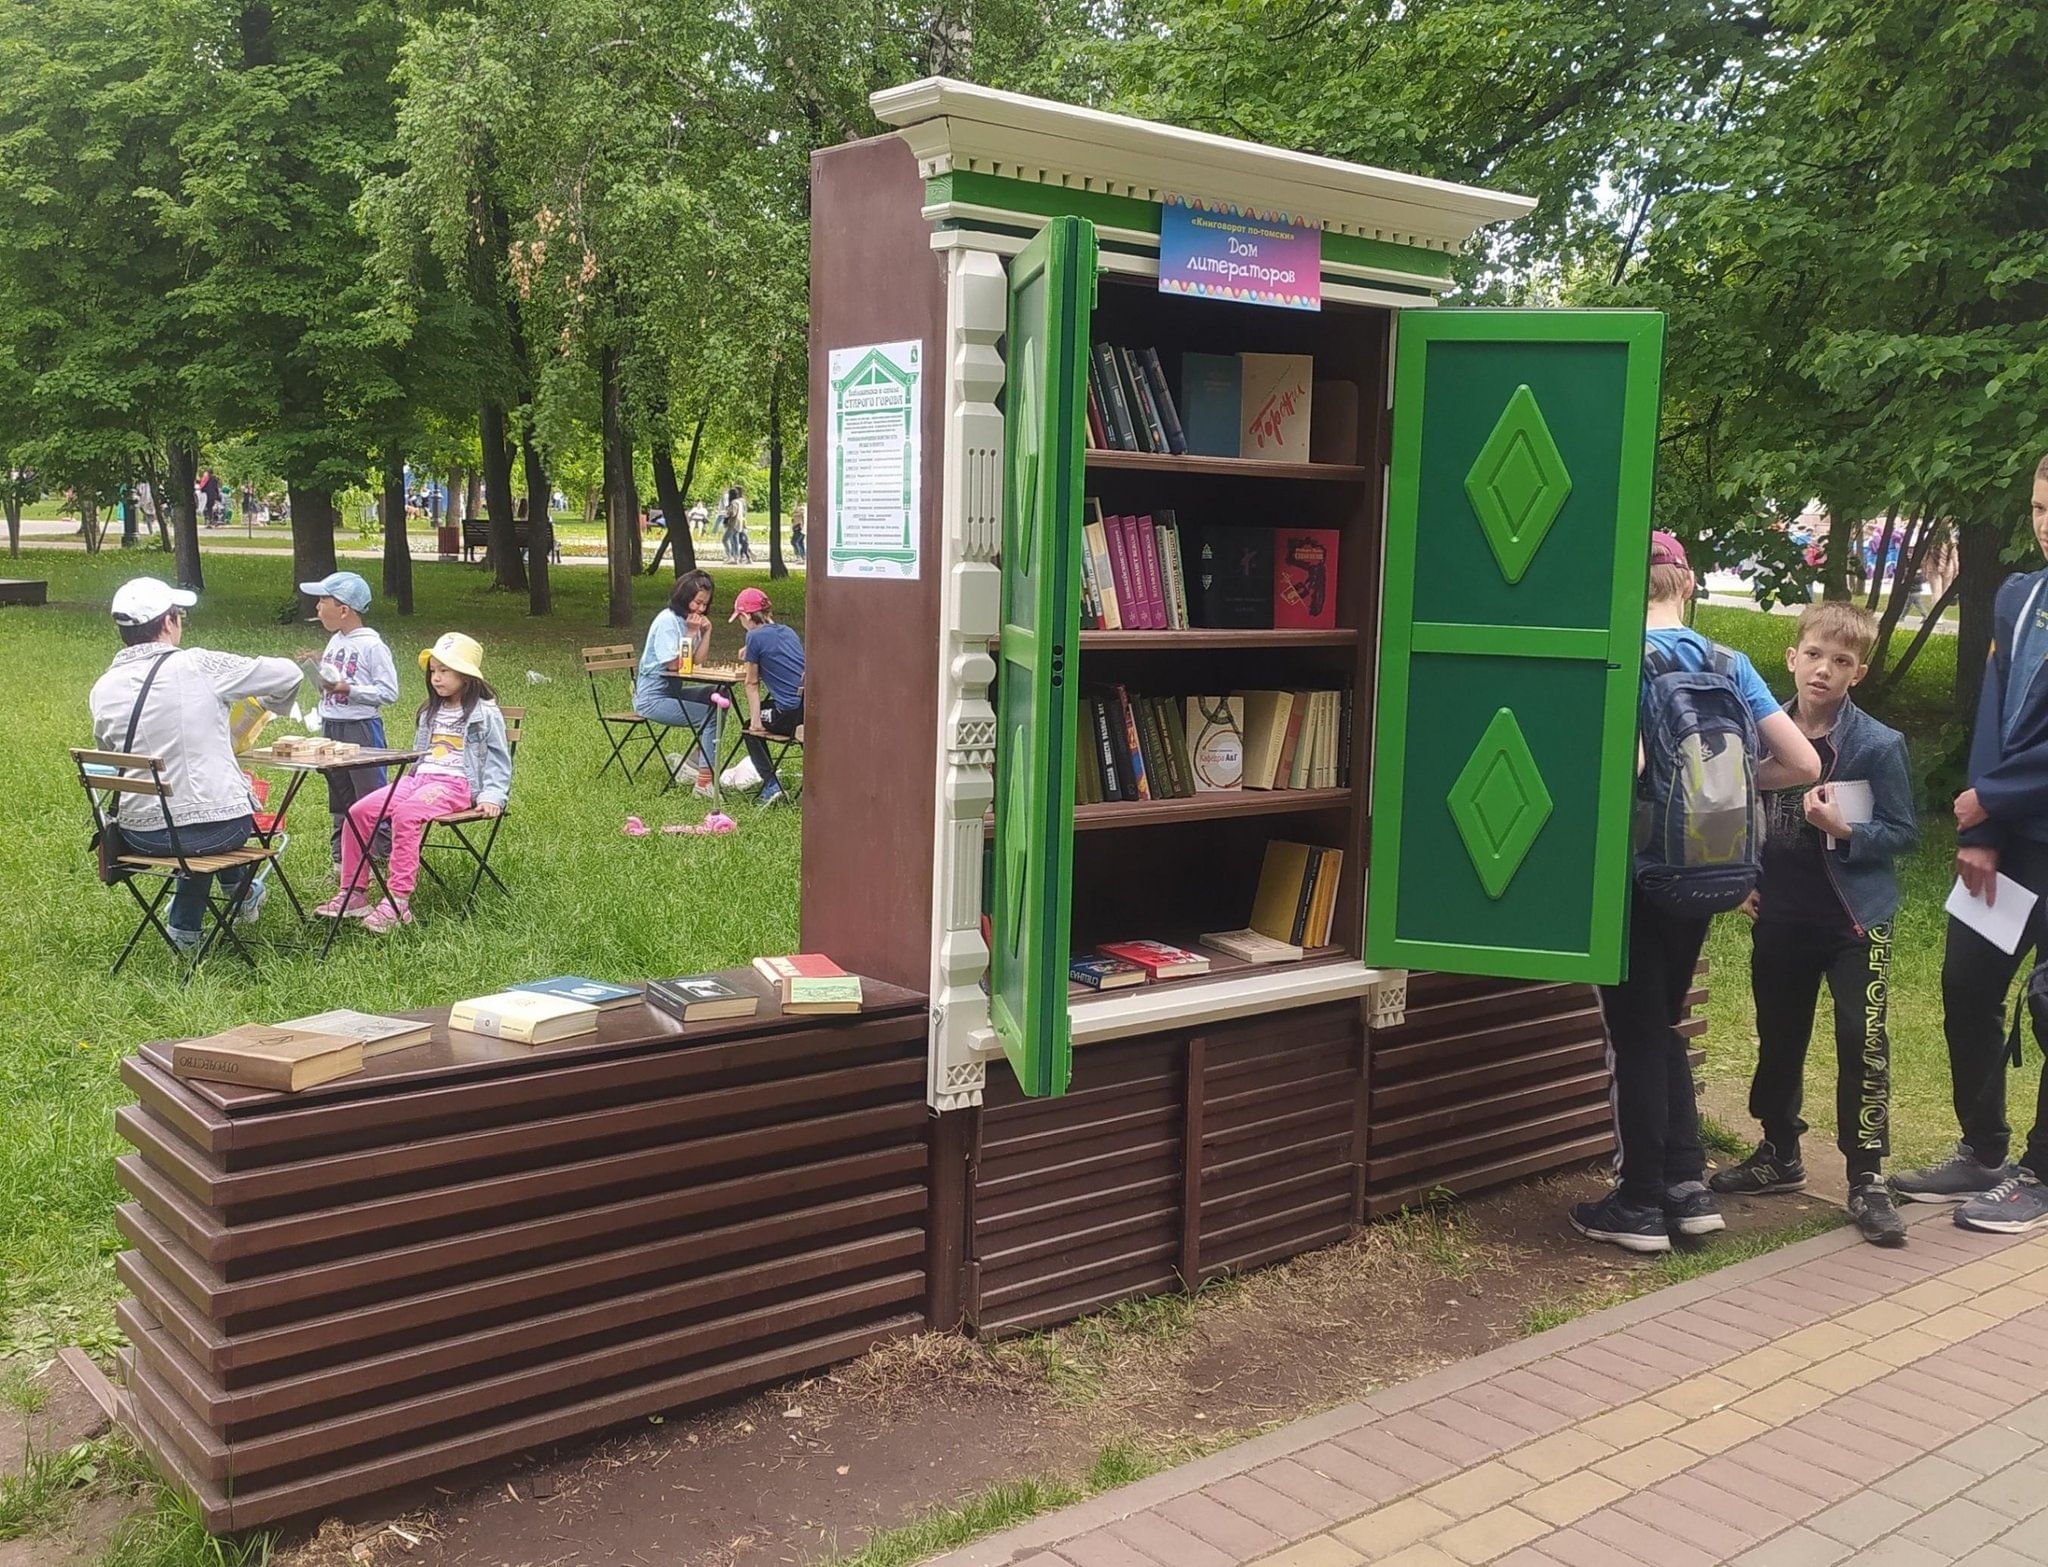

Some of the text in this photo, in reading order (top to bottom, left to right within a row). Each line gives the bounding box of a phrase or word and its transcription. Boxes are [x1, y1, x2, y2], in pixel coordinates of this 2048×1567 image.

[1191, 217, 1247, 233] «Книговорот
[1228, 236, 1258, 258] Дом
[1187, 256, 1295, 287] литераторов
